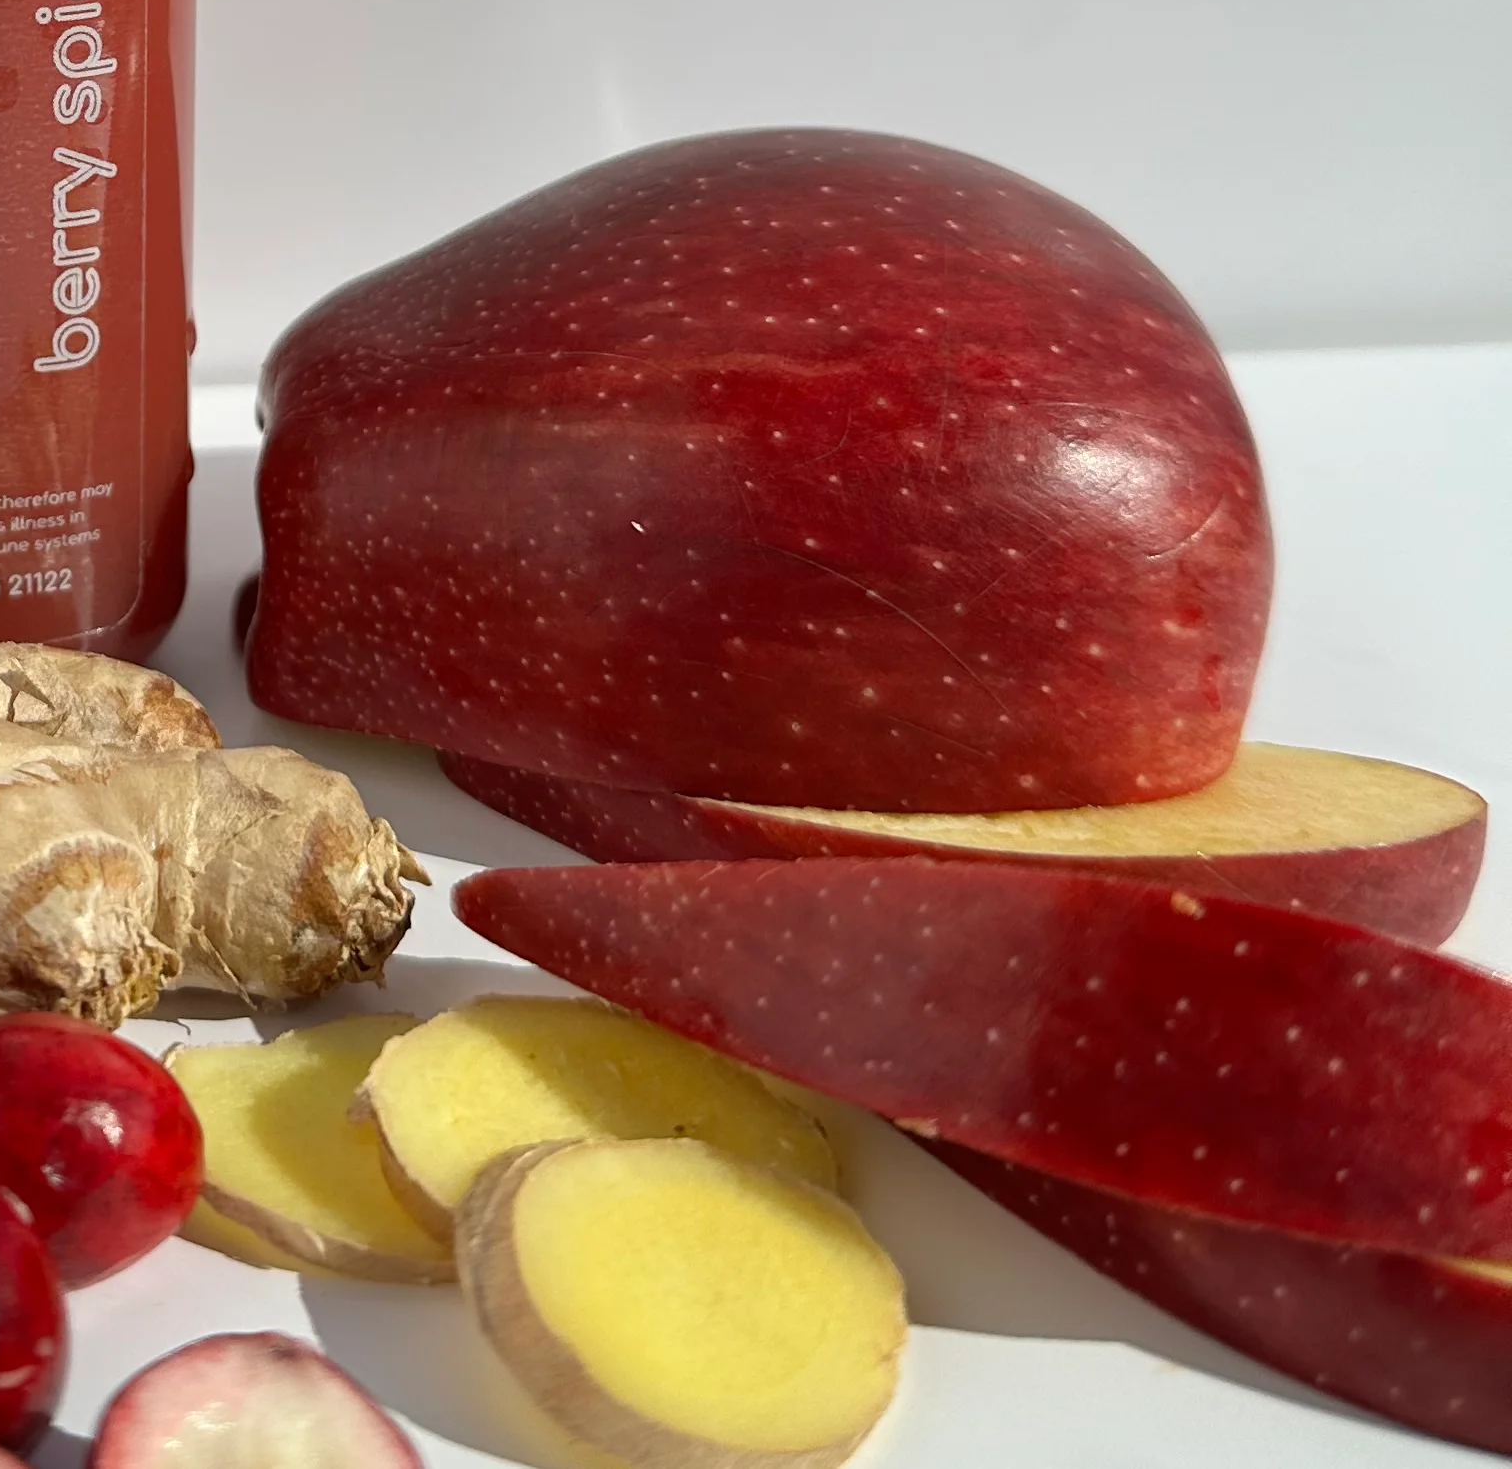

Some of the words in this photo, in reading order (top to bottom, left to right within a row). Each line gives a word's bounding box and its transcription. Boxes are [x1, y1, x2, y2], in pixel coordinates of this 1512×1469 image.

[33, 147, 117, 373] berry
[81, 481, 114, 504] may
[10, 512, 66, 532] illness
[69, 508, 86, 525] in
[33, 527, 101, 552] systems
[8, 567, 72, 596] 21122
